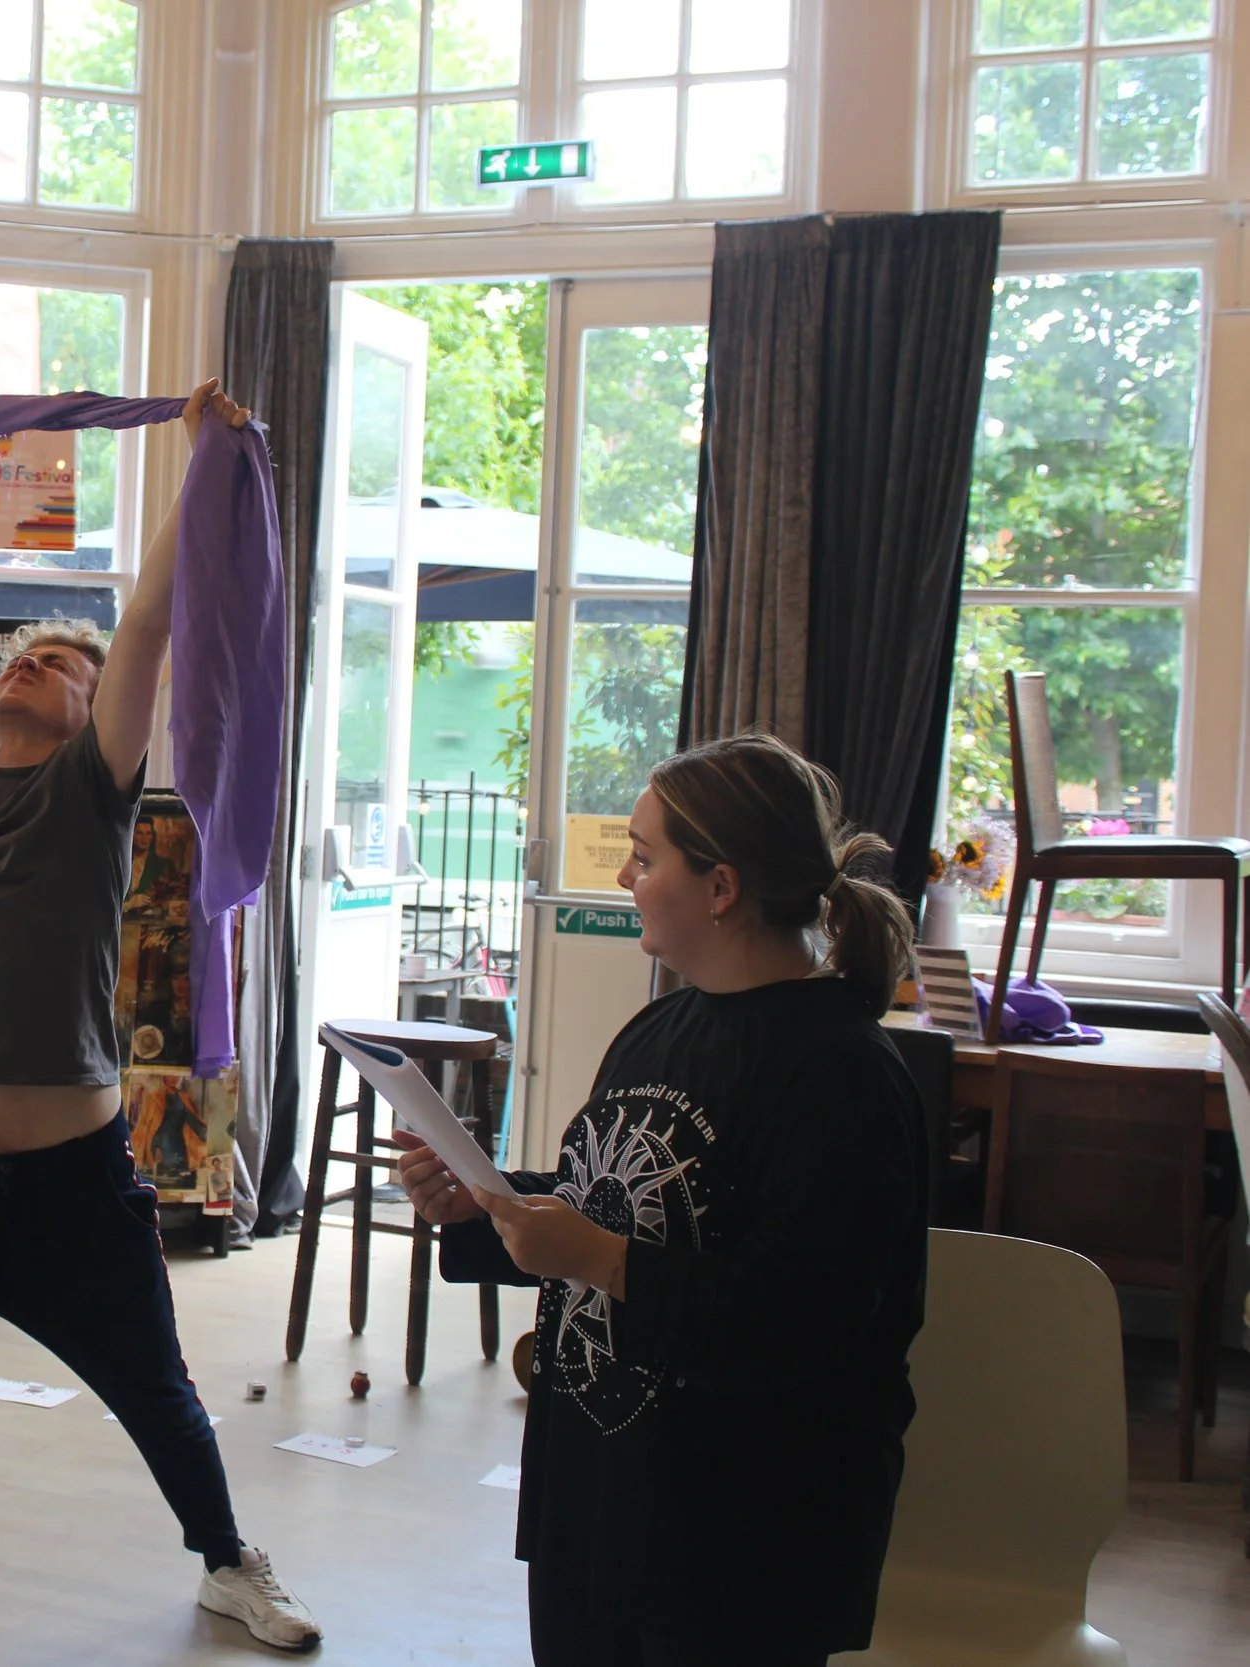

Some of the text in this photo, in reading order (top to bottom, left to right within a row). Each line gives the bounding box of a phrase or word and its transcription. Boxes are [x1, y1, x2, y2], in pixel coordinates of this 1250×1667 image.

[15, 464, 75, 483] Festival
[585, 911, 626, 927] Push
[627, 1083, 667, 1099] soleil
[690, 1107, 716, 1144] lune
